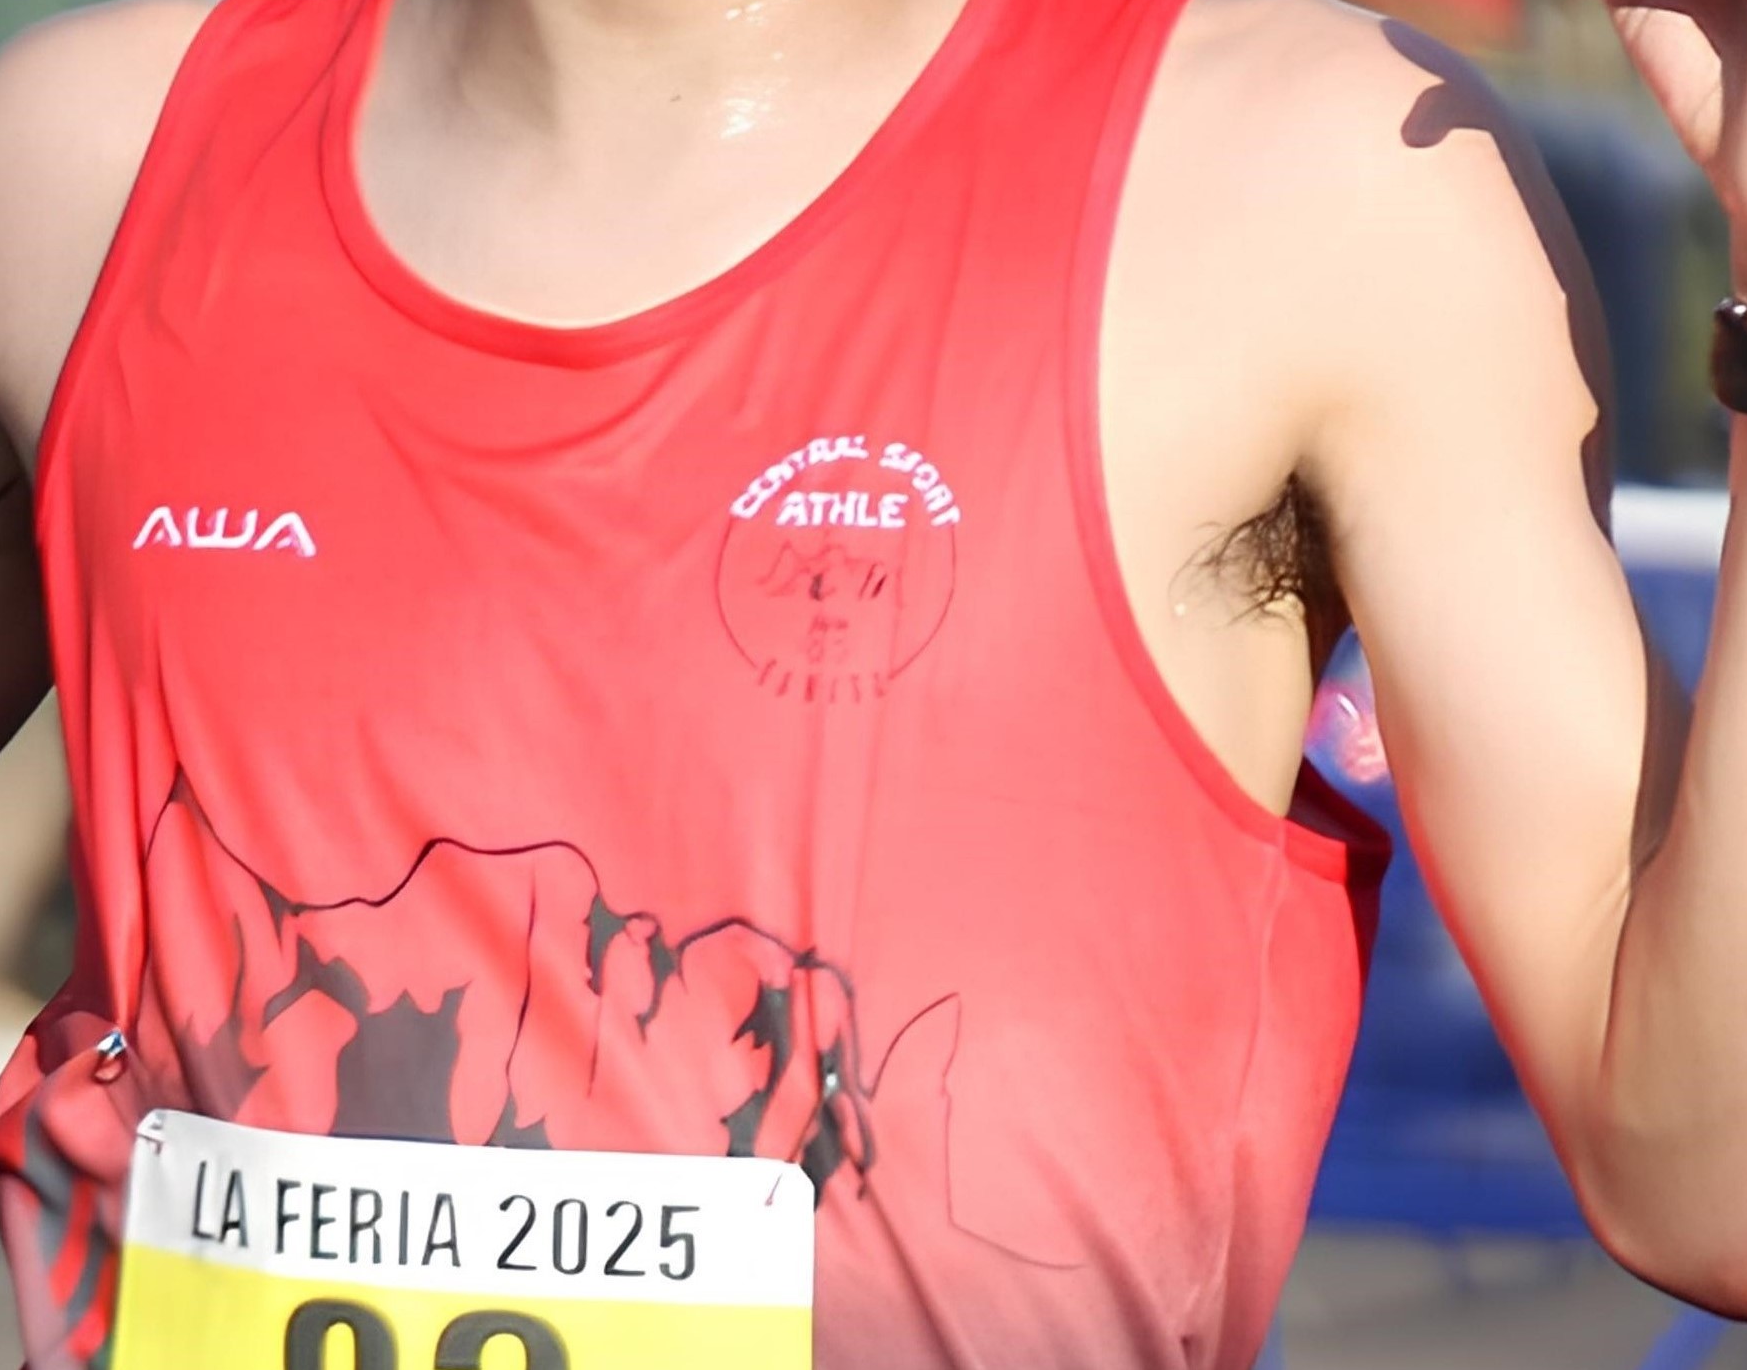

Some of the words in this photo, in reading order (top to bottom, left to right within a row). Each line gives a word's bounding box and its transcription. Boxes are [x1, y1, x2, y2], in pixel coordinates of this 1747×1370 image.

[132, 506, 317, 557] AWA
[775, 491, 909, 528] ATHLE
[191, 1160, 249, 1248] LA
[275, 1179, 461, 1267] FERIA
[496, 1195, 700, 1281] 2025
